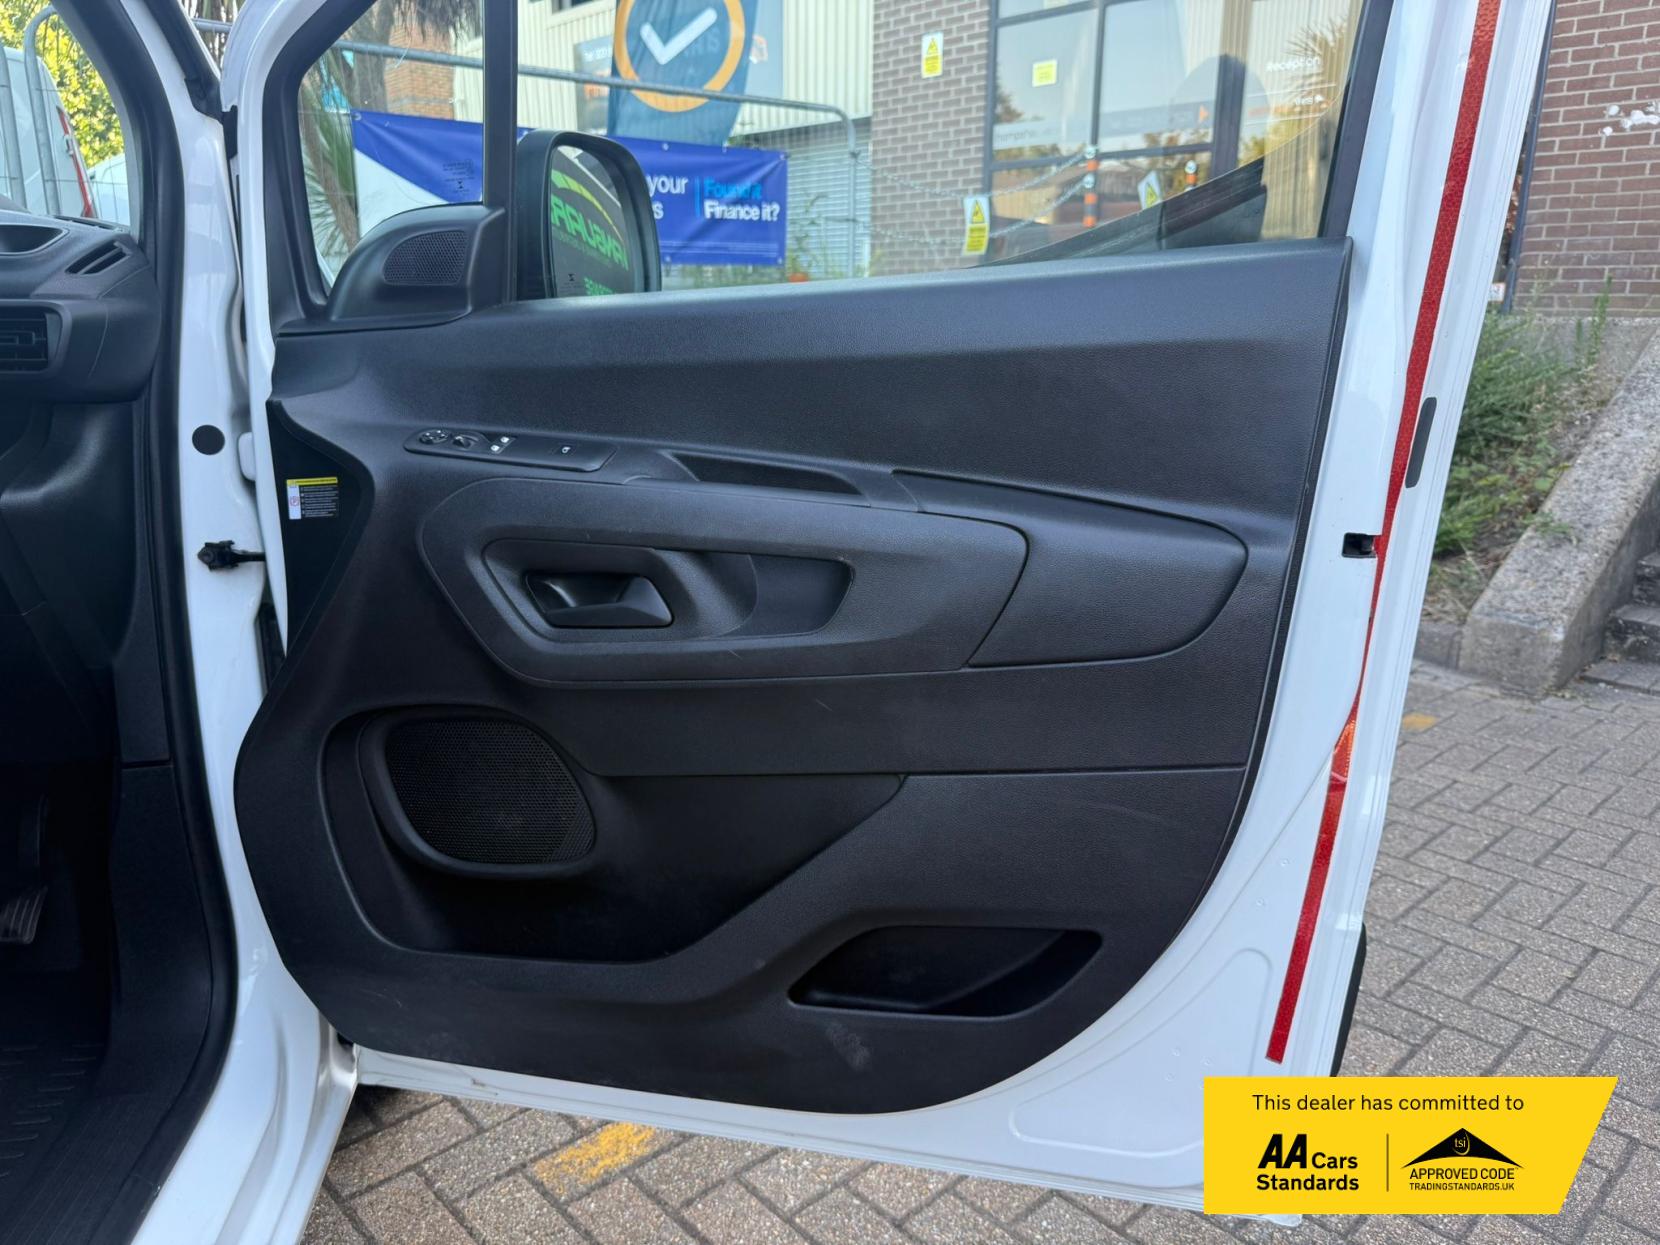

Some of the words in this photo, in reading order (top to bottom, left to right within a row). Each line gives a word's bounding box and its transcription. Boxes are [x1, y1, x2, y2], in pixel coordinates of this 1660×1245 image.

[646, 175, 689, 197] your
[704, 199, 760, 220] Finance
[761, 201, 780, 221] it?
